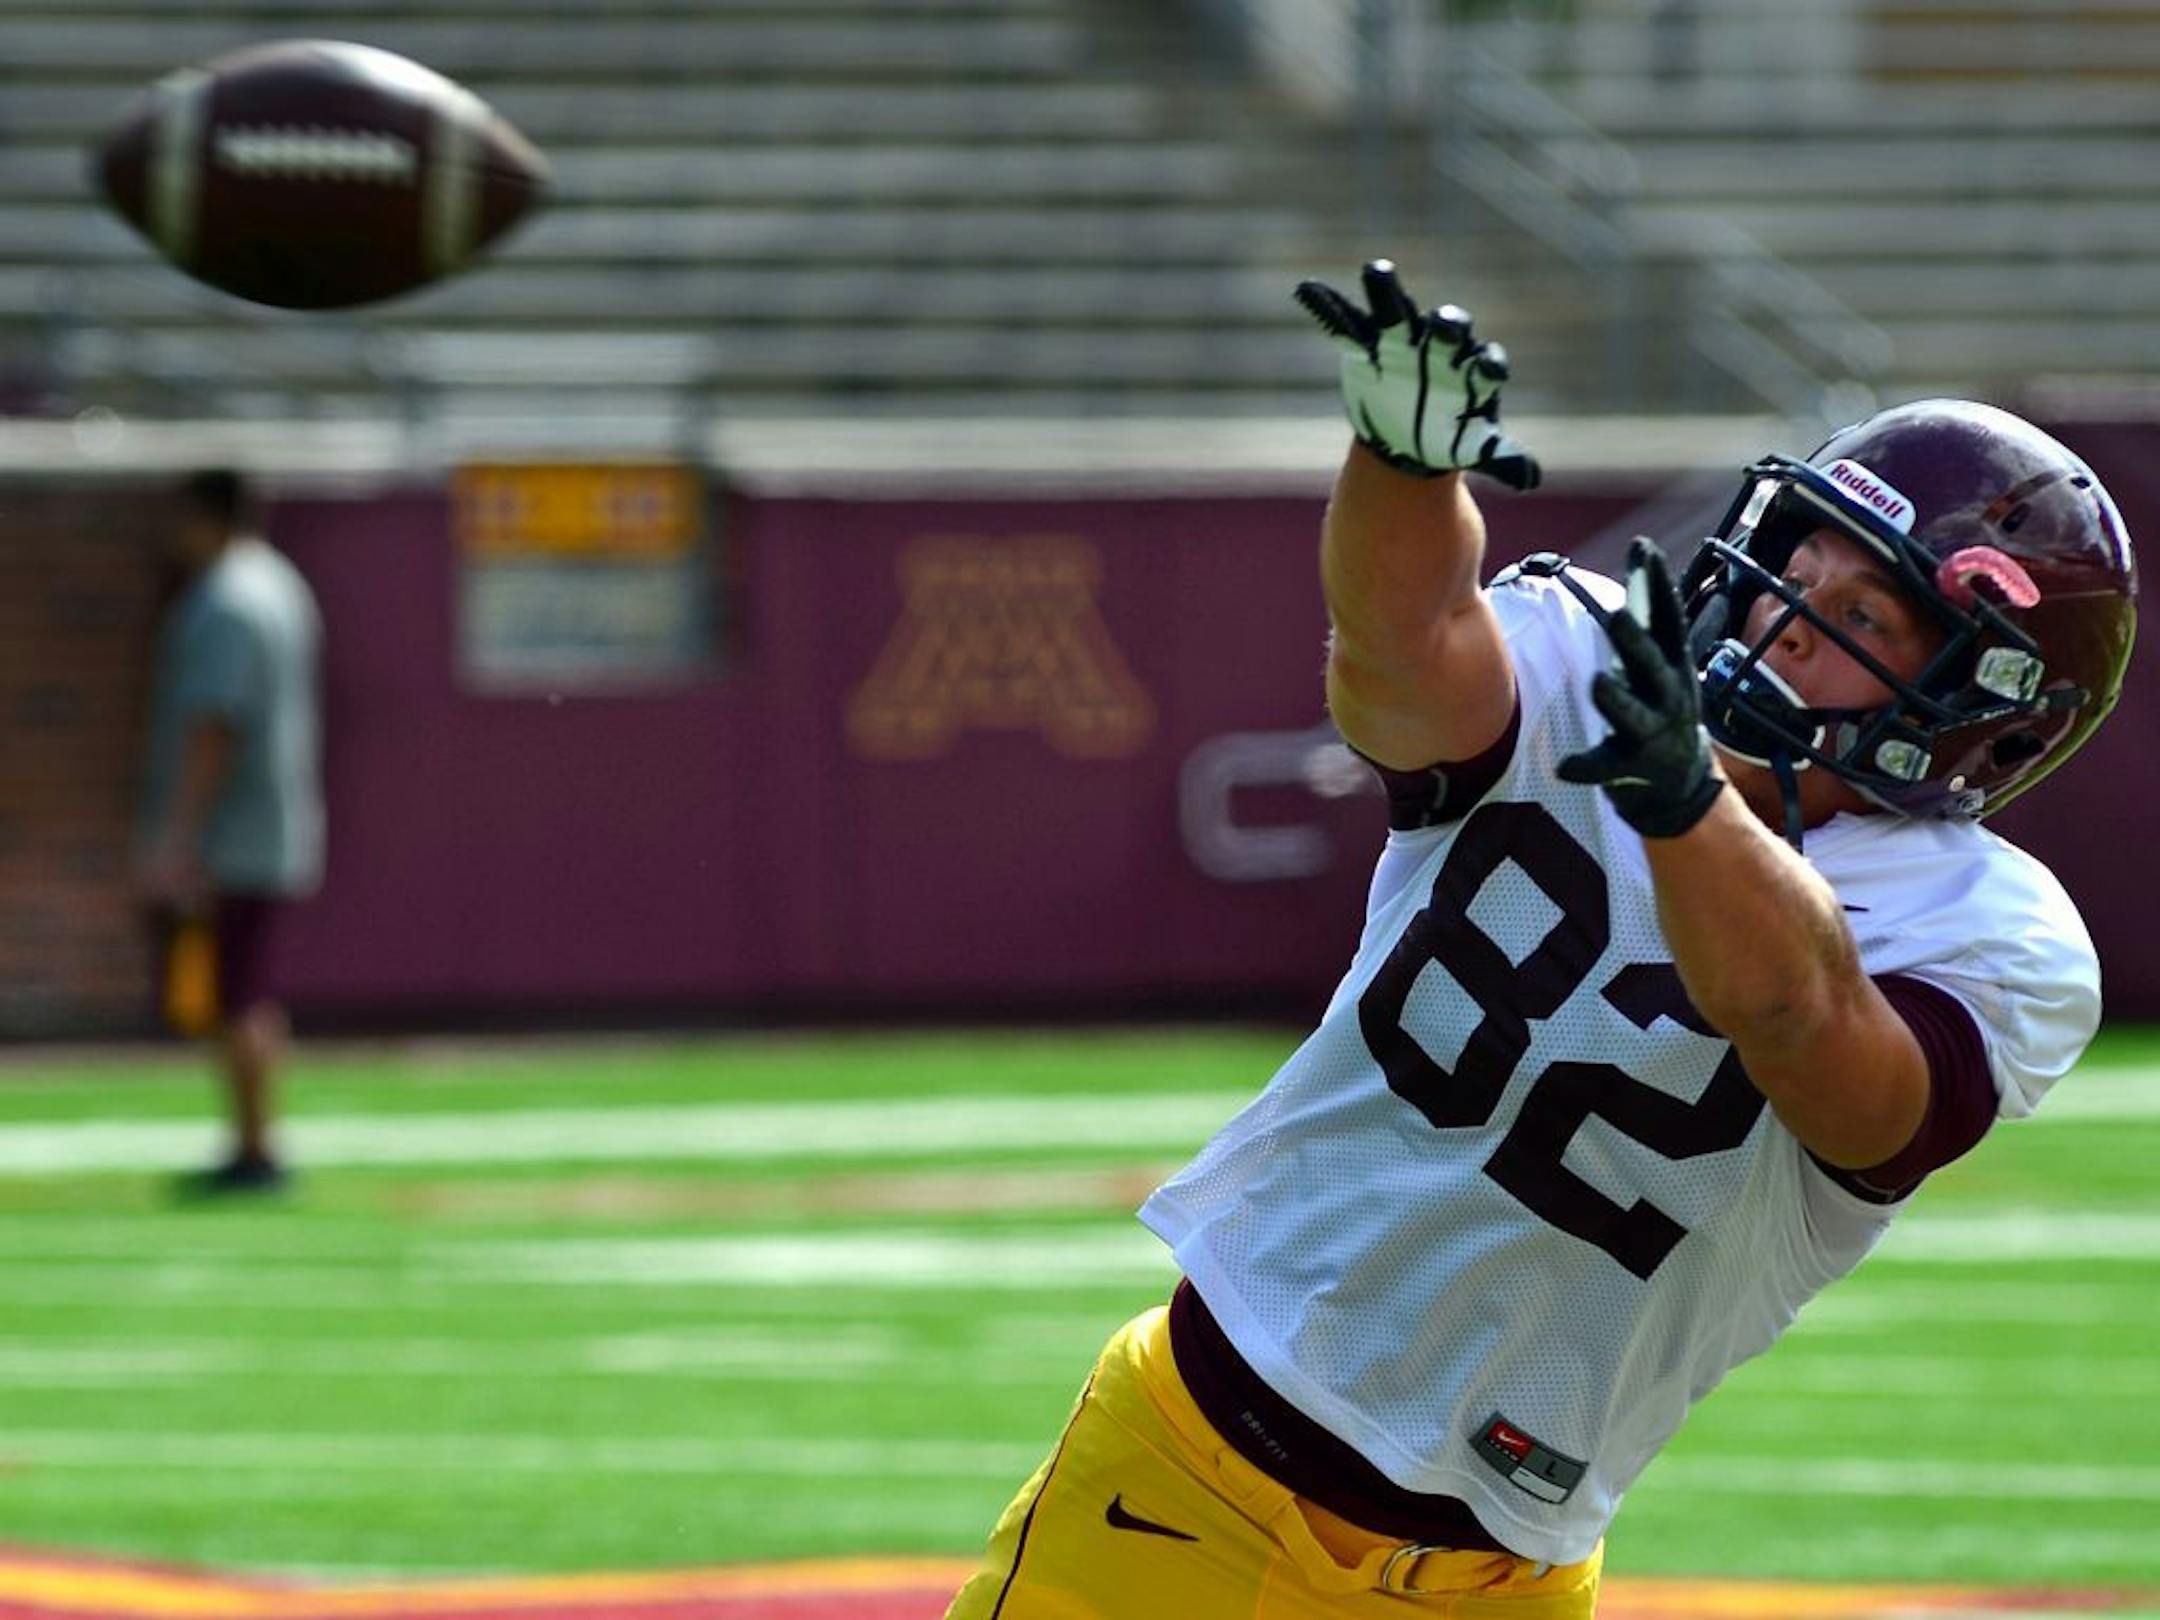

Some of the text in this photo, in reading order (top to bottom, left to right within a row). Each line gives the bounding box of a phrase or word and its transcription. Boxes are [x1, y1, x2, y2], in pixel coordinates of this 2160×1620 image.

[1829, 463, 1906, 520] Riddell
[1358, 801, 1769, 1282] 82
[1545, 1460, 1556, 1479] L
